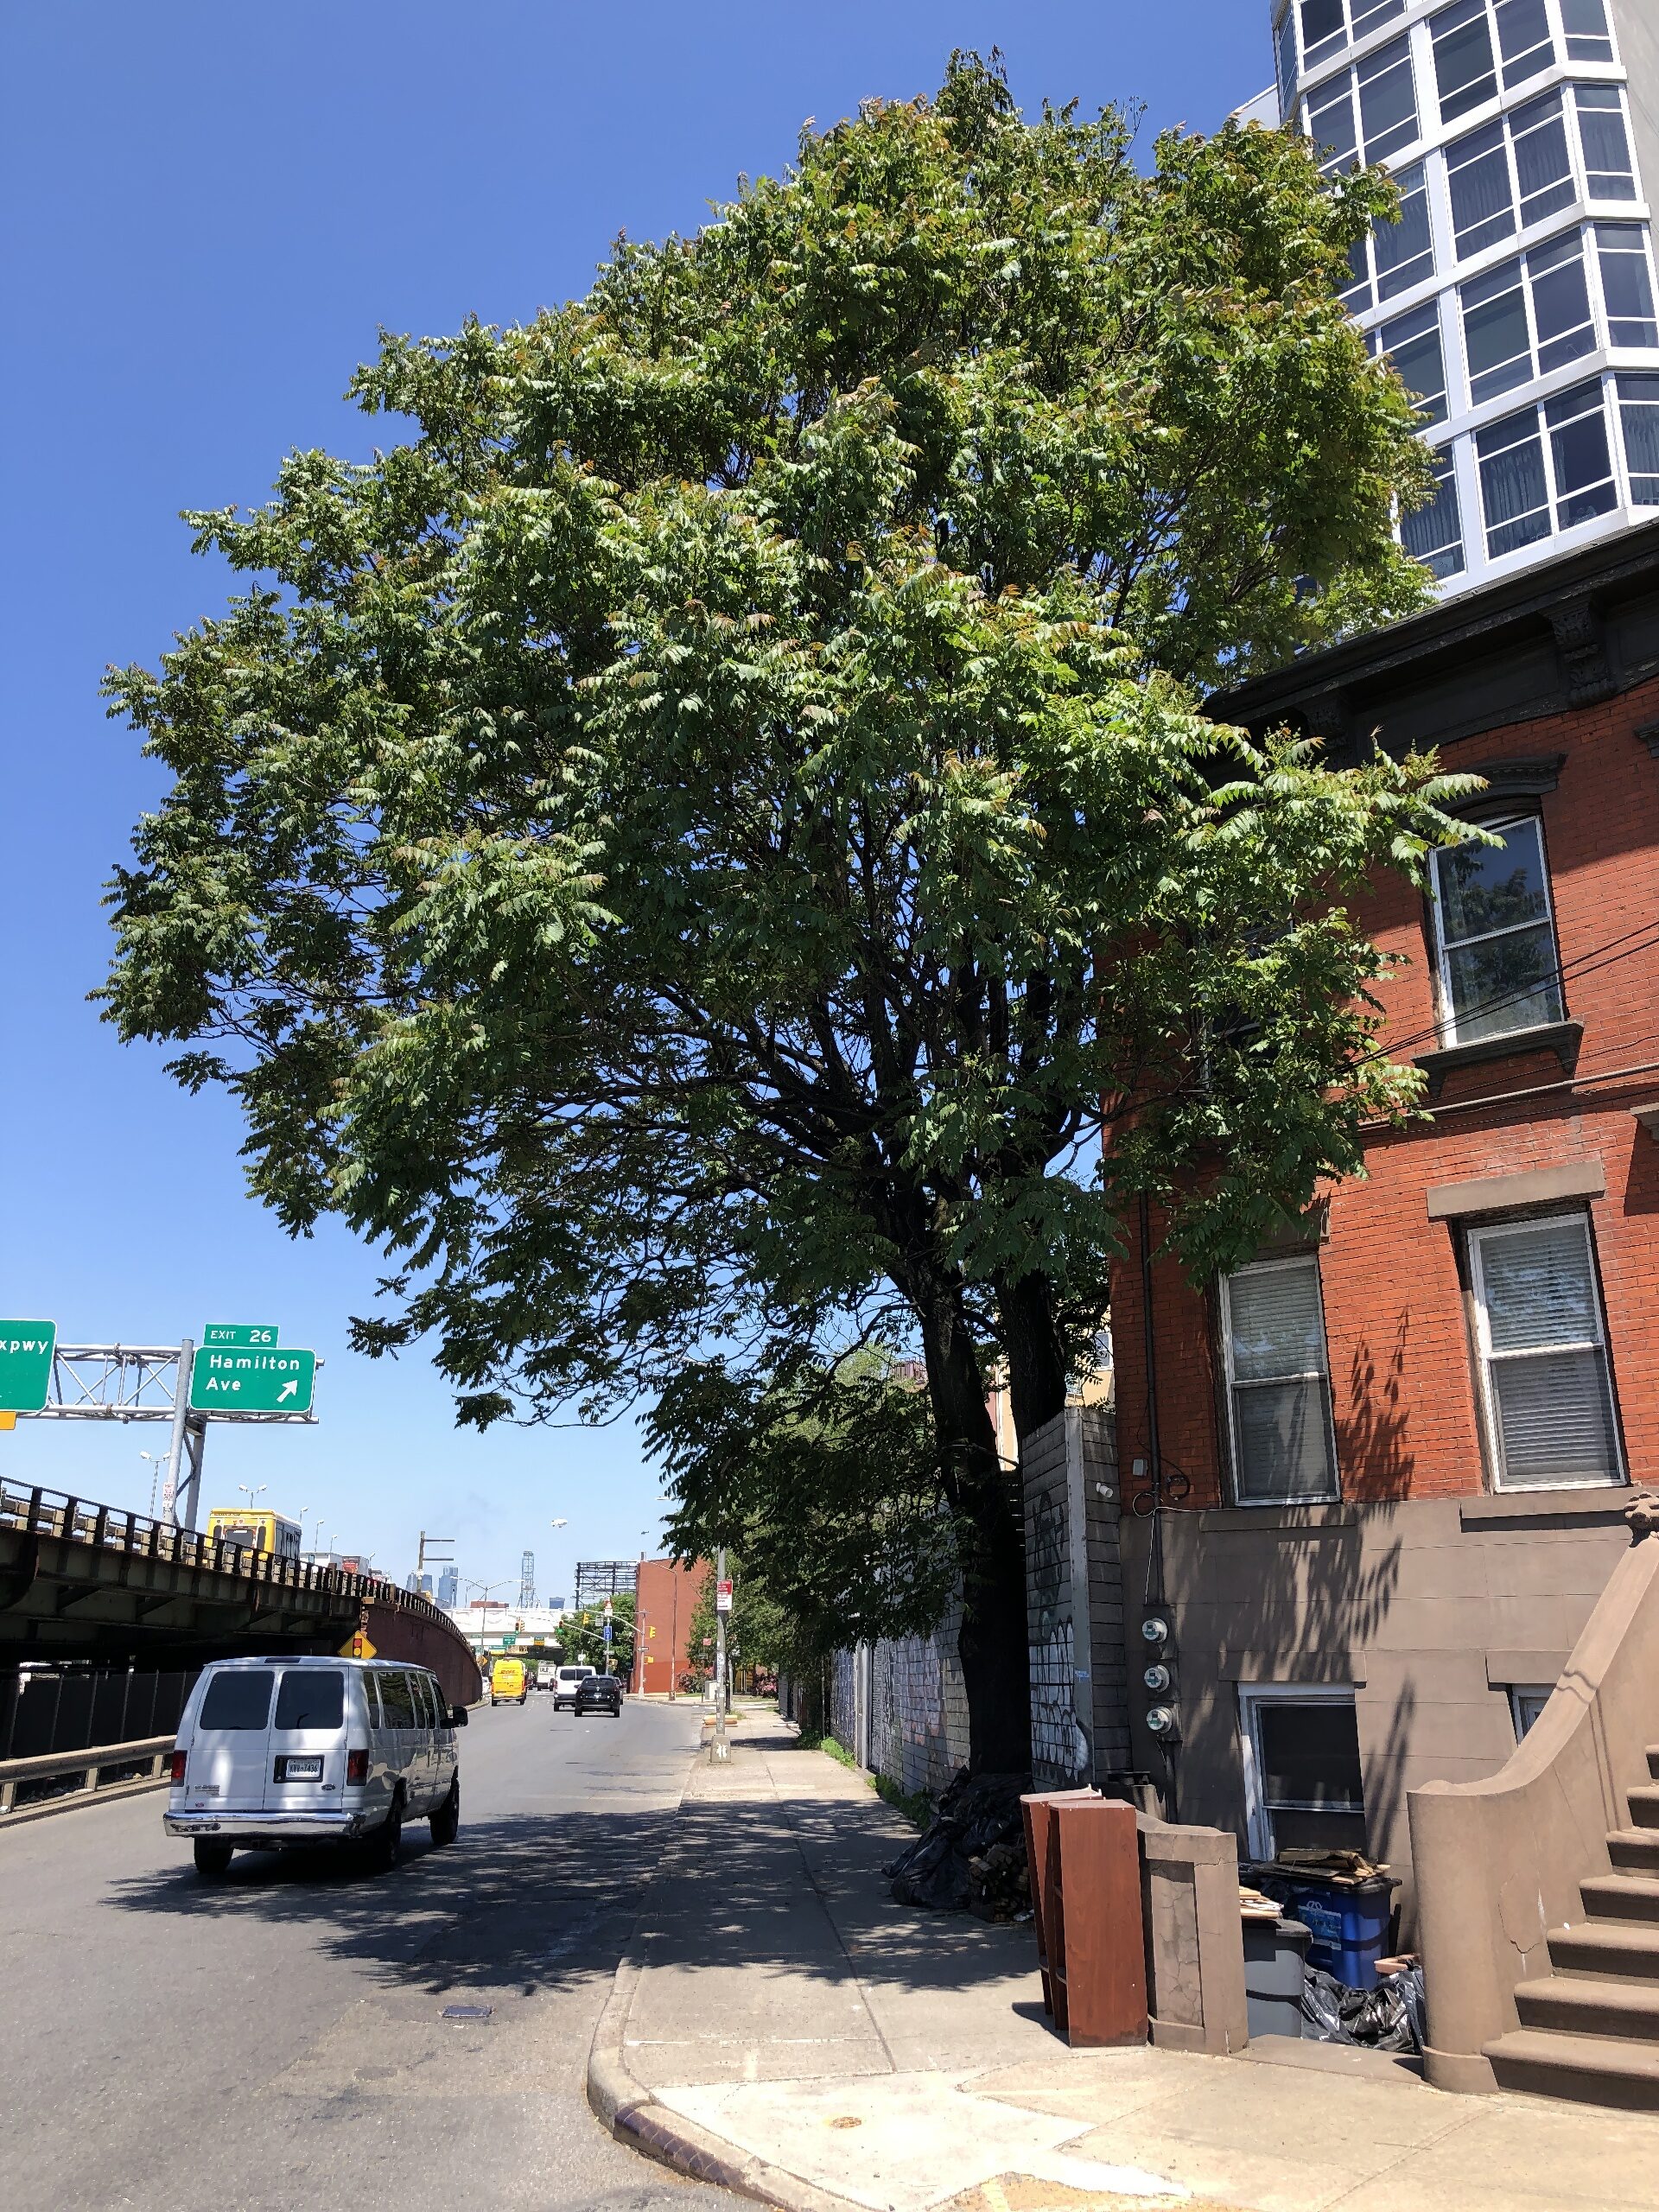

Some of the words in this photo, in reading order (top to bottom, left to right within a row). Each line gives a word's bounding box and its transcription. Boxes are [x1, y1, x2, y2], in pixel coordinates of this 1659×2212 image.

[210, 1330, 237, 1340] EXIT
[249, 1329, 272, 1343] 26
[209, 1354, 300, 1370] Hamilton
[205, 1376, 241, 1391] Ave
